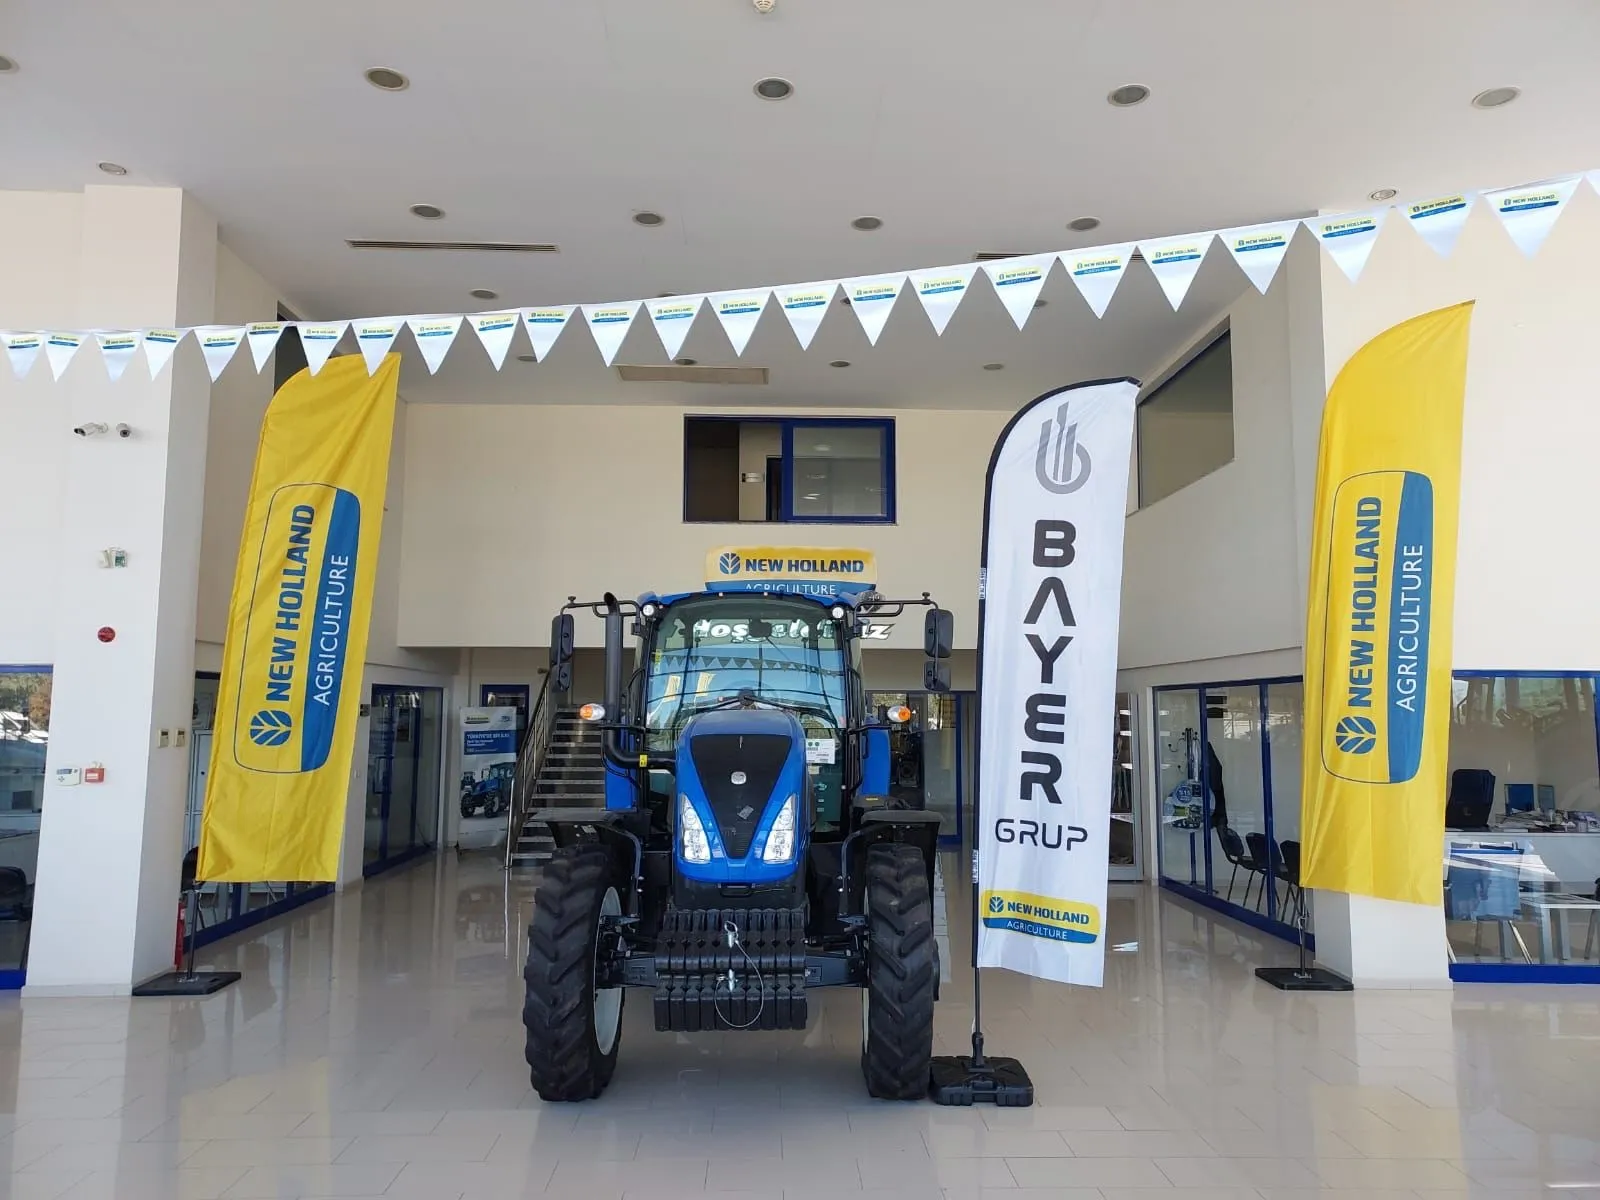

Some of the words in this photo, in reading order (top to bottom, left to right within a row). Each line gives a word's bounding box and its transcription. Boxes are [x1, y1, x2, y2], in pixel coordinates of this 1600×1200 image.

[276, 504, 314, 632] HOLLAND
[746, 559, 783, 572] NEW
[788, 560, 864, 572] HOLLAND
[1352, 496, 1382, 633] HOLLAND
[313, 554, 349, 705] AGRICULTURE
[1396, 544, 1422, 712] AGRICULTURE
[266, 637, 296, 701] NEW
[1348, 640, 1375, 707] NEW
[995, 818, 1088, 851] GRUP
[1006, 920, 1068, 940] AGRICULTURE
[1008, 902, 1032, 914] NEW
[1034, 906, 1090, 924] HOLLAND
